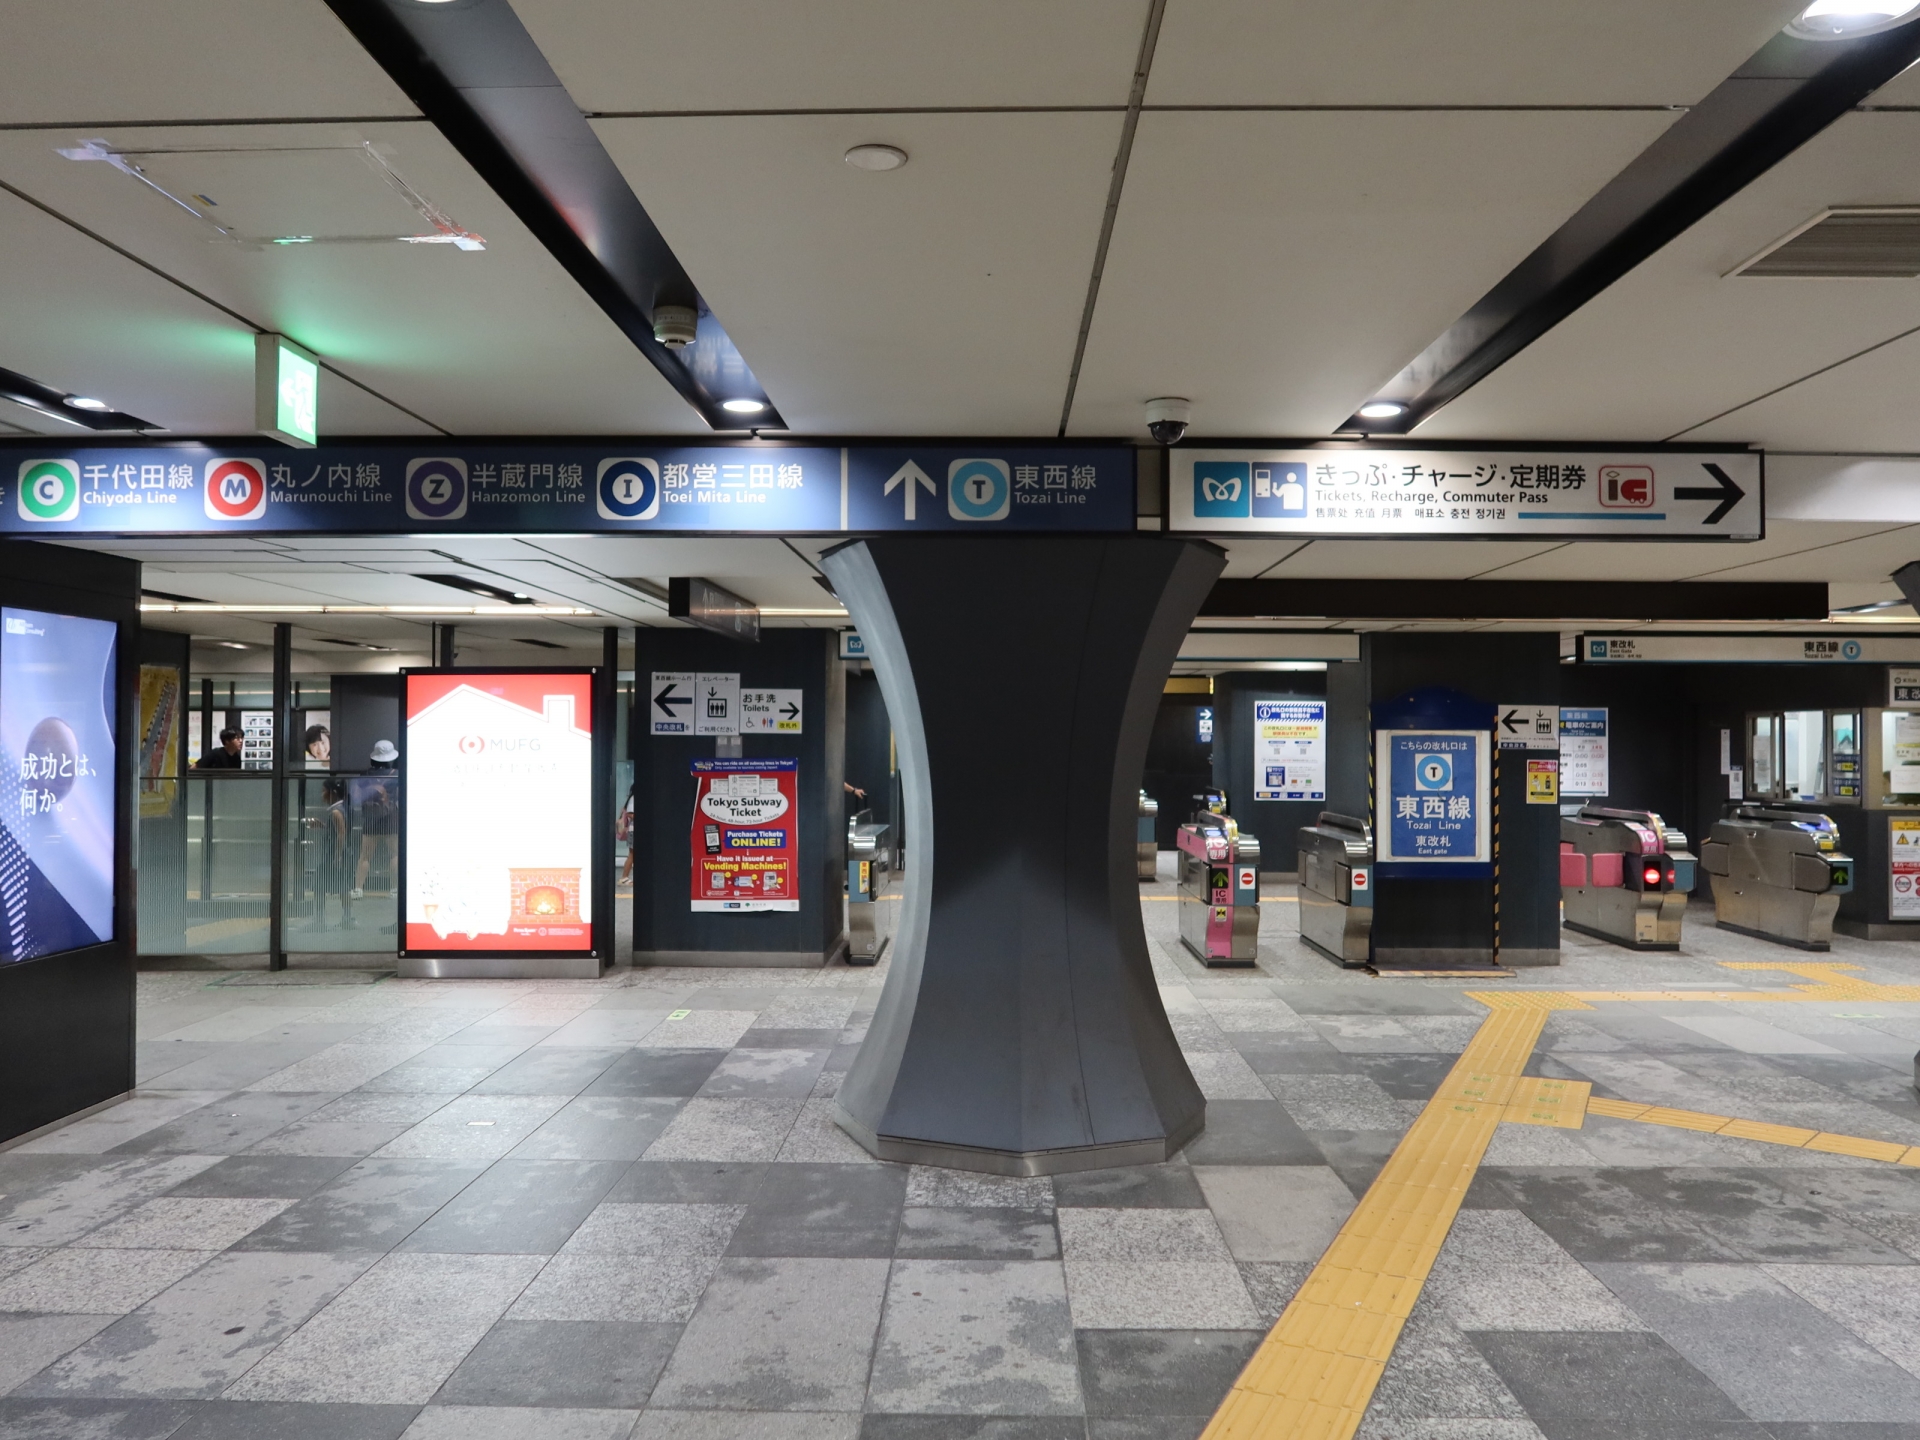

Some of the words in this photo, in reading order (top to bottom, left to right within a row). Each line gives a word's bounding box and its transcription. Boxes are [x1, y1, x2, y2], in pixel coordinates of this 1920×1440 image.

[83, 464, 194, 490] 千代田線
[270, 463, 382, 489] 丸ノ内線
[472, 463, 583, 489] 半蔵門線
[663, 463, 804, 489] 都営三田線
[1014, 464, 1097, 490] 東西線
[39, 479, 54, 500] C
[224, 478, 248, 498] M
[428, 478, 445, 498] Z
[623, 478, 633, 498] I
[972, 480, 986, 499] T
[83, 491, 142, 505] Chiyoda
[147, 491, 177, 504] Line
[270, 491, 358, 503] Marunouchi
[362, 491, 393, 503] Line
[472, 491, 550, 503] Hanzomon
[556, 491, 586, 503] Line
[663, 491, 693, 503] Toei
[697, 491, 731, 503] Mita
[735, 491, 767, 503] Line
[1014, 492, 1052, 504] Tozai
[1057, 492, 1087, 504] Line
[1315, 490, 1366, 502] Tickets,
[1372, 490, 1438, 505] Recharge,
[1443, 491, 1515, 503] Commuter
[1519, 492, 1549, 503] Pass
[1315, 507, 1348, 518] 售票处
[1355, 507, 1376, 518] 充值
[1381, 507, 1402, 518] 月票
[1415, 508, 1445, 518] 매표소
[1450, 508, 1470, 519] 충전
[1476, 508, 1506, 519] 정기권
[1610, 640, 1636, 649] 東改札
[1804, 641, 1839, 653] 東西線
[1849, 646, 1855, 654] T
[742, 693, 777, 704] お手洗
[742, 704, 770, 712] Toilets
[490, 739, 541, 751] MUFG
[1400, 741, 1468, 751] こちらの改札口は
[20, 752, 97, 781] 成功とは、
[1430, 766, 1438, 778] T
[20, 788, 63, 817] 何か。
[707, 798, 739, 808] Tokyo
[741, 798, 783, 808] Subway
[1396, 795, 1471, 820] 東西線
[730, 808, 762, 817] Ticket
[1406, 820, 1432, 830] Tozai
[1438, 820, 1461, 830] Line
[731, 838, 781, 847] ONLINE!
[1415, 835, 1451, 847] 東改札
[704, 862, 739, 872] Vending
[741, 862, 787, 870] Machines!
[1215, 890, 1226, 898] IC
